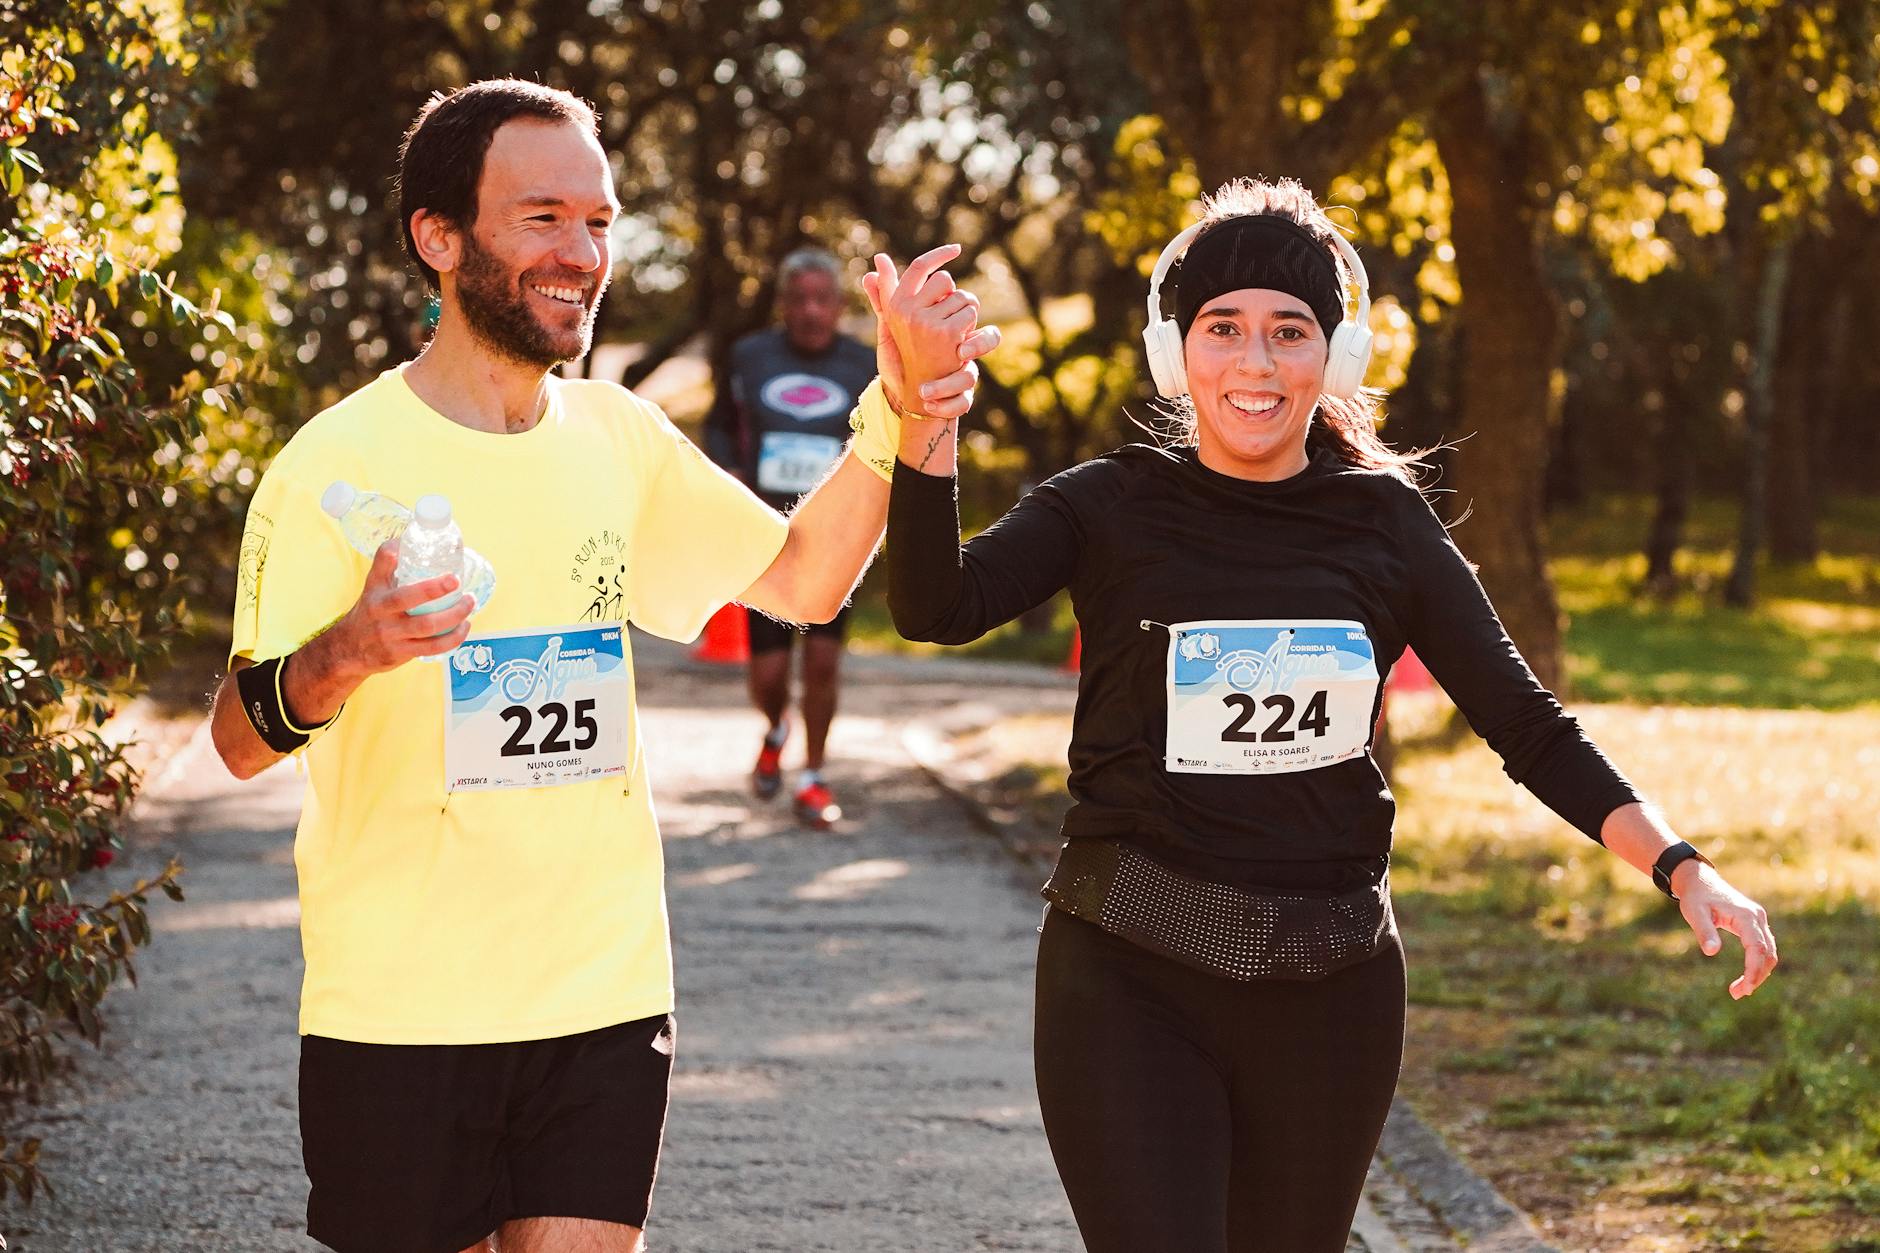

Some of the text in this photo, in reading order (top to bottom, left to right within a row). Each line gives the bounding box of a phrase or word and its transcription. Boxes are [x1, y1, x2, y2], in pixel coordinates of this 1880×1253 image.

[601, 632, 619, 642] 10KM
[559, 647, 596, 658] CORRIDA DA
[1221, 690, 1330, 743] 224
[499, 698, 598, 757] 225
[1243, 749, 1268, 757] ELISA
[1278, 746, 1310, 756] SOARES
[527, 758, 582, 770] NUNO GOMES
[457, 777, 488, 786] XISTARCA
